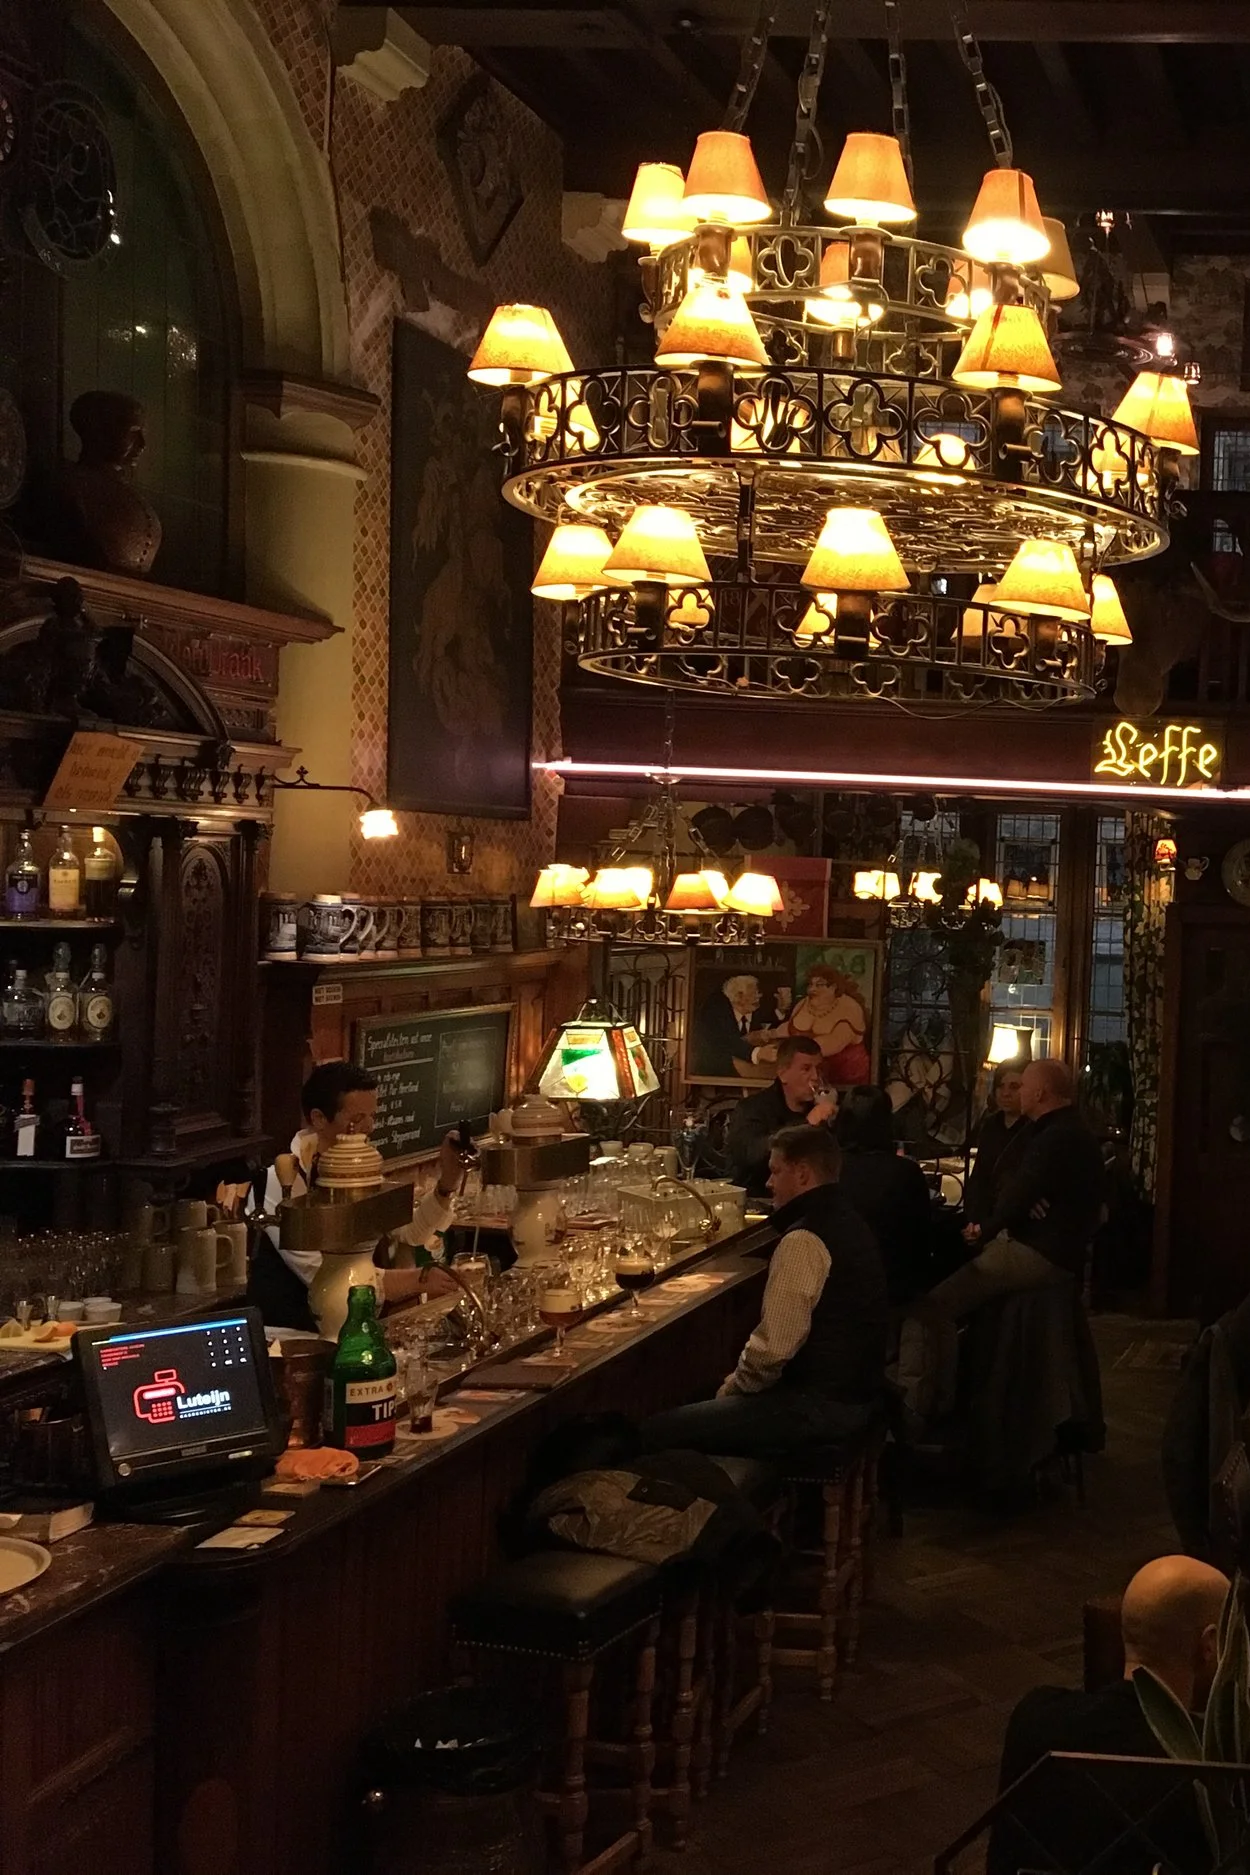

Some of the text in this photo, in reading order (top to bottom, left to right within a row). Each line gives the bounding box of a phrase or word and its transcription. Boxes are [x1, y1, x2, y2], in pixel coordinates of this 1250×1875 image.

[1094, 722, 1218, 786] Leffe
[176, 1389, 230, 1409] Luteijn
[349, 1385, 384, 1397] EXTRA
[371, 1400, 397, 1421] TIP
